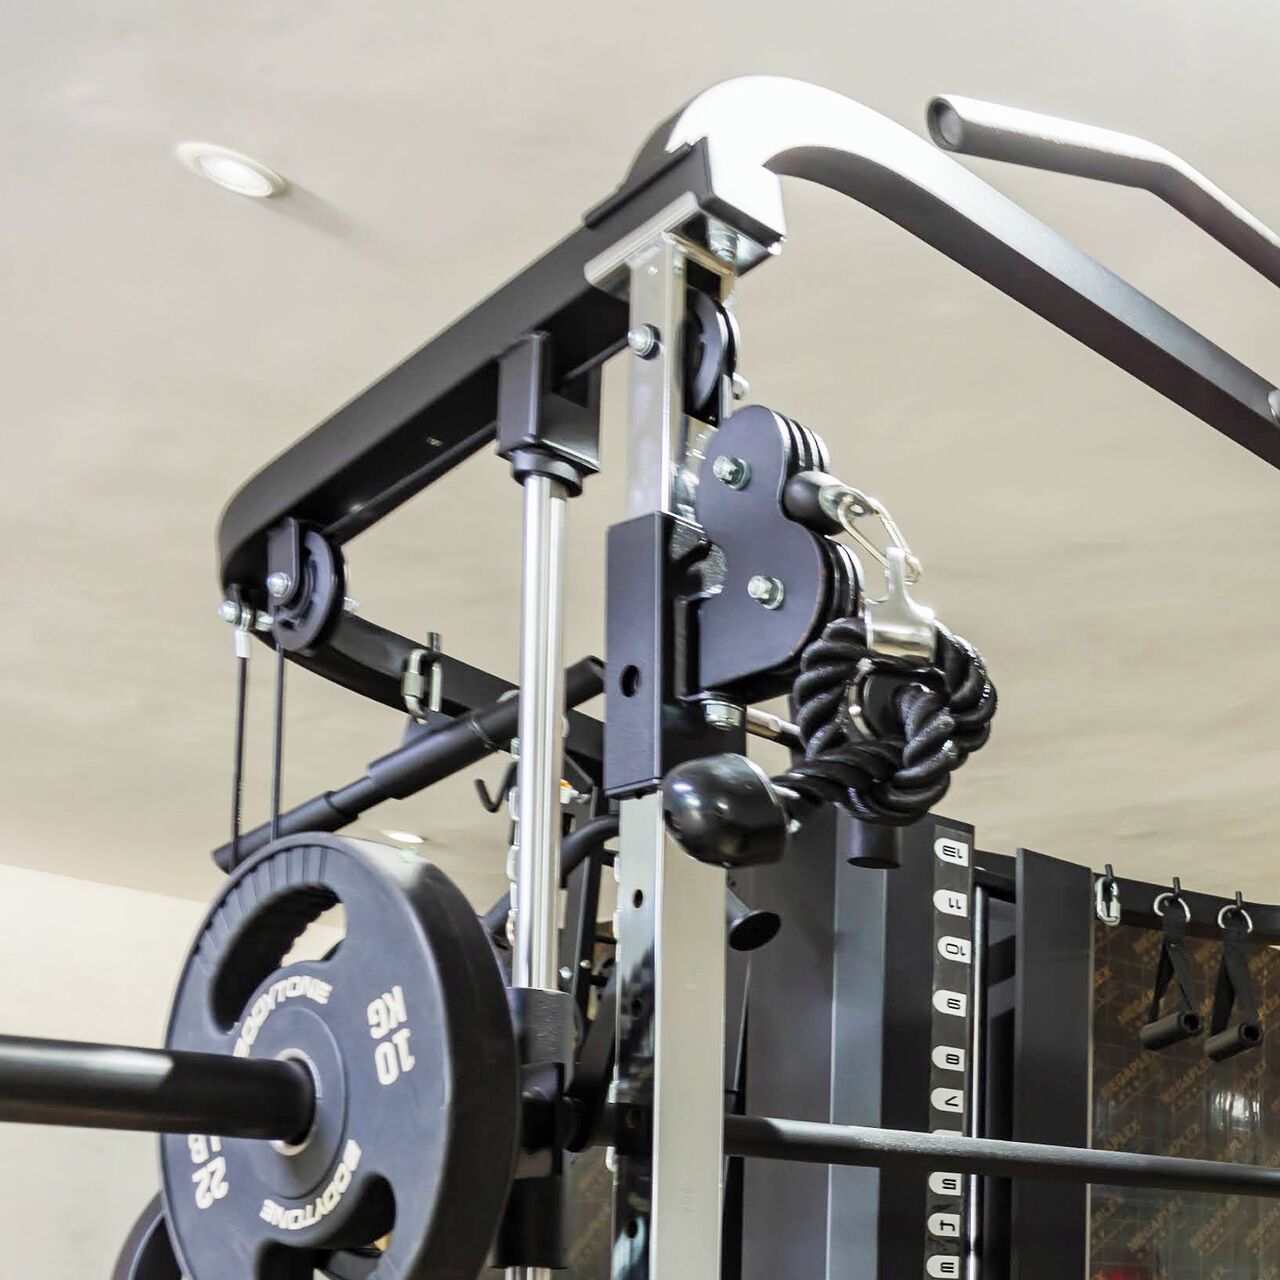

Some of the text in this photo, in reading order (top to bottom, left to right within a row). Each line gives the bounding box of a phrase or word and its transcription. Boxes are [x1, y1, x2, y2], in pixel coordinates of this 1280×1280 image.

[945, 943, 966, 956] 10
[947, 998, 961, 1010] 9
[367, 985, 408, 1040] KG
[375, 1028, 416, 1086] 10
[945, 1053, 960, 1065] 8
[944, 1095, 960, 1107] 7
[192, 1156, 230, 1209] 22
[941, 1178, 957, 1191] 5
[939, 1219, 956, 1232] 4
[940, 1262, 955, 1273] 3
